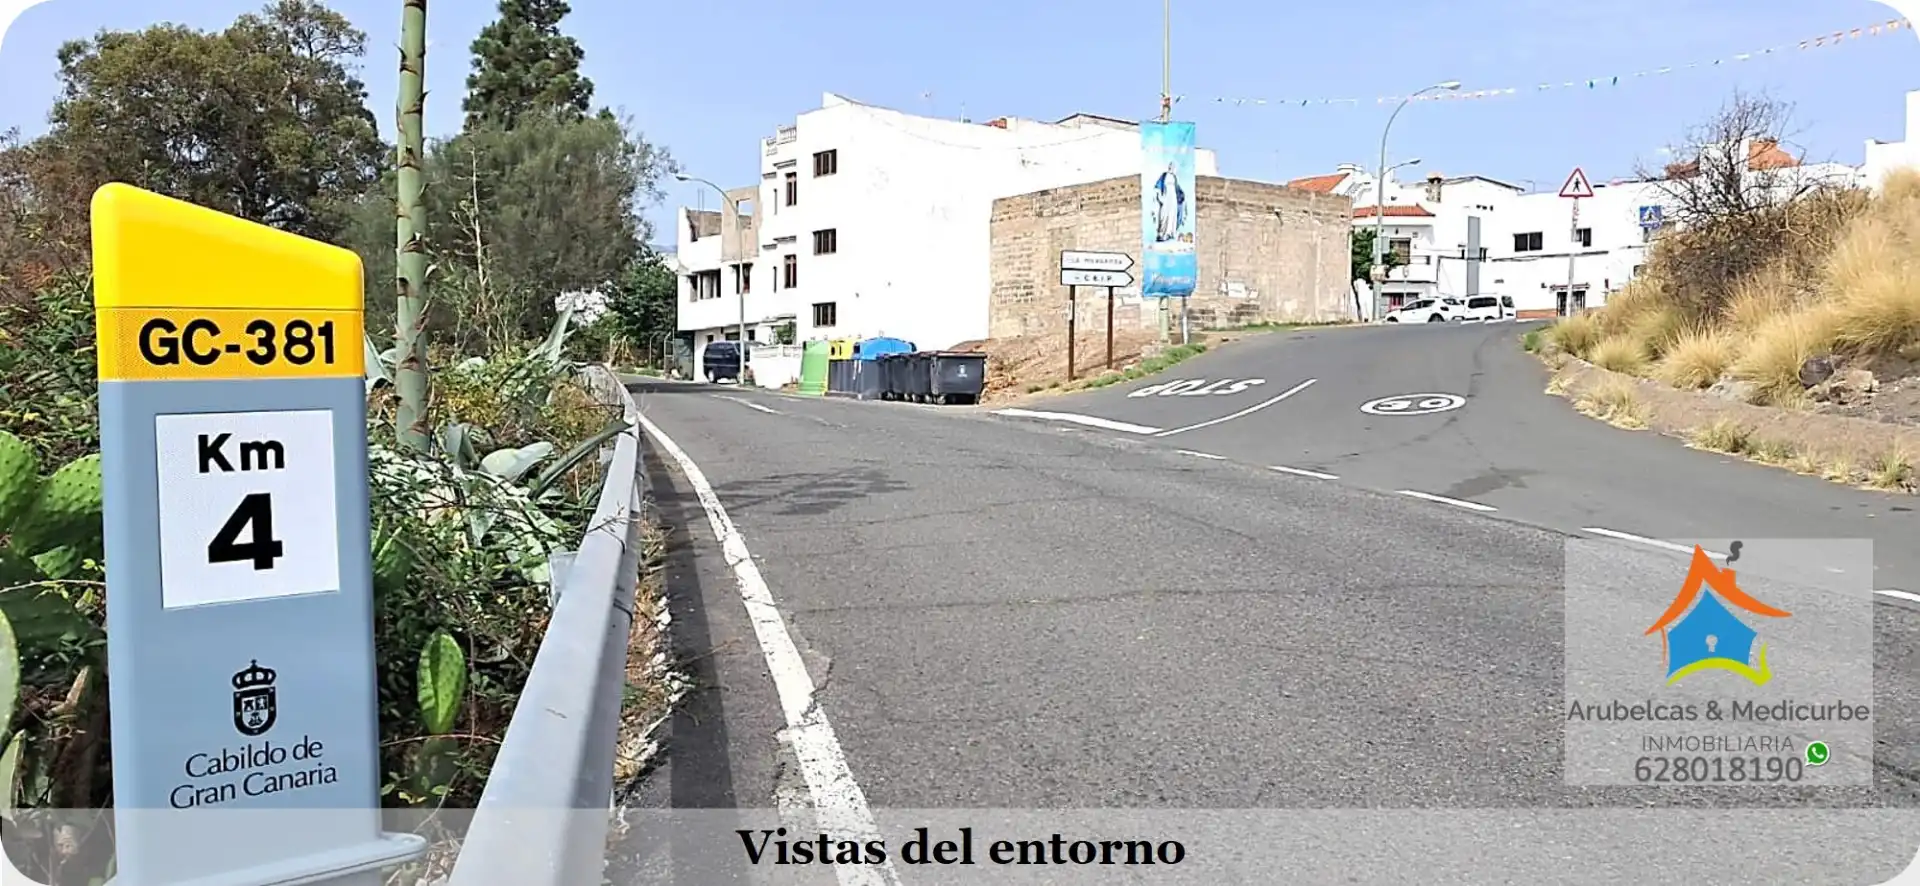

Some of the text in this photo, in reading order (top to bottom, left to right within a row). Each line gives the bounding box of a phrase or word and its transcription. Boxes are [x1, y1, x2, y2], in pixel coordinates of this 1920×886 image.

[138, 318, 335, 366] GC-381
[1127, 379, 1266, 398] STOP
[197, 433, 286, 473] Km
[207, 492, 283, 571] 4
[185, 735, 323, 778] Cabildo de
[170, 763, 337, 809] Gran Canaria
